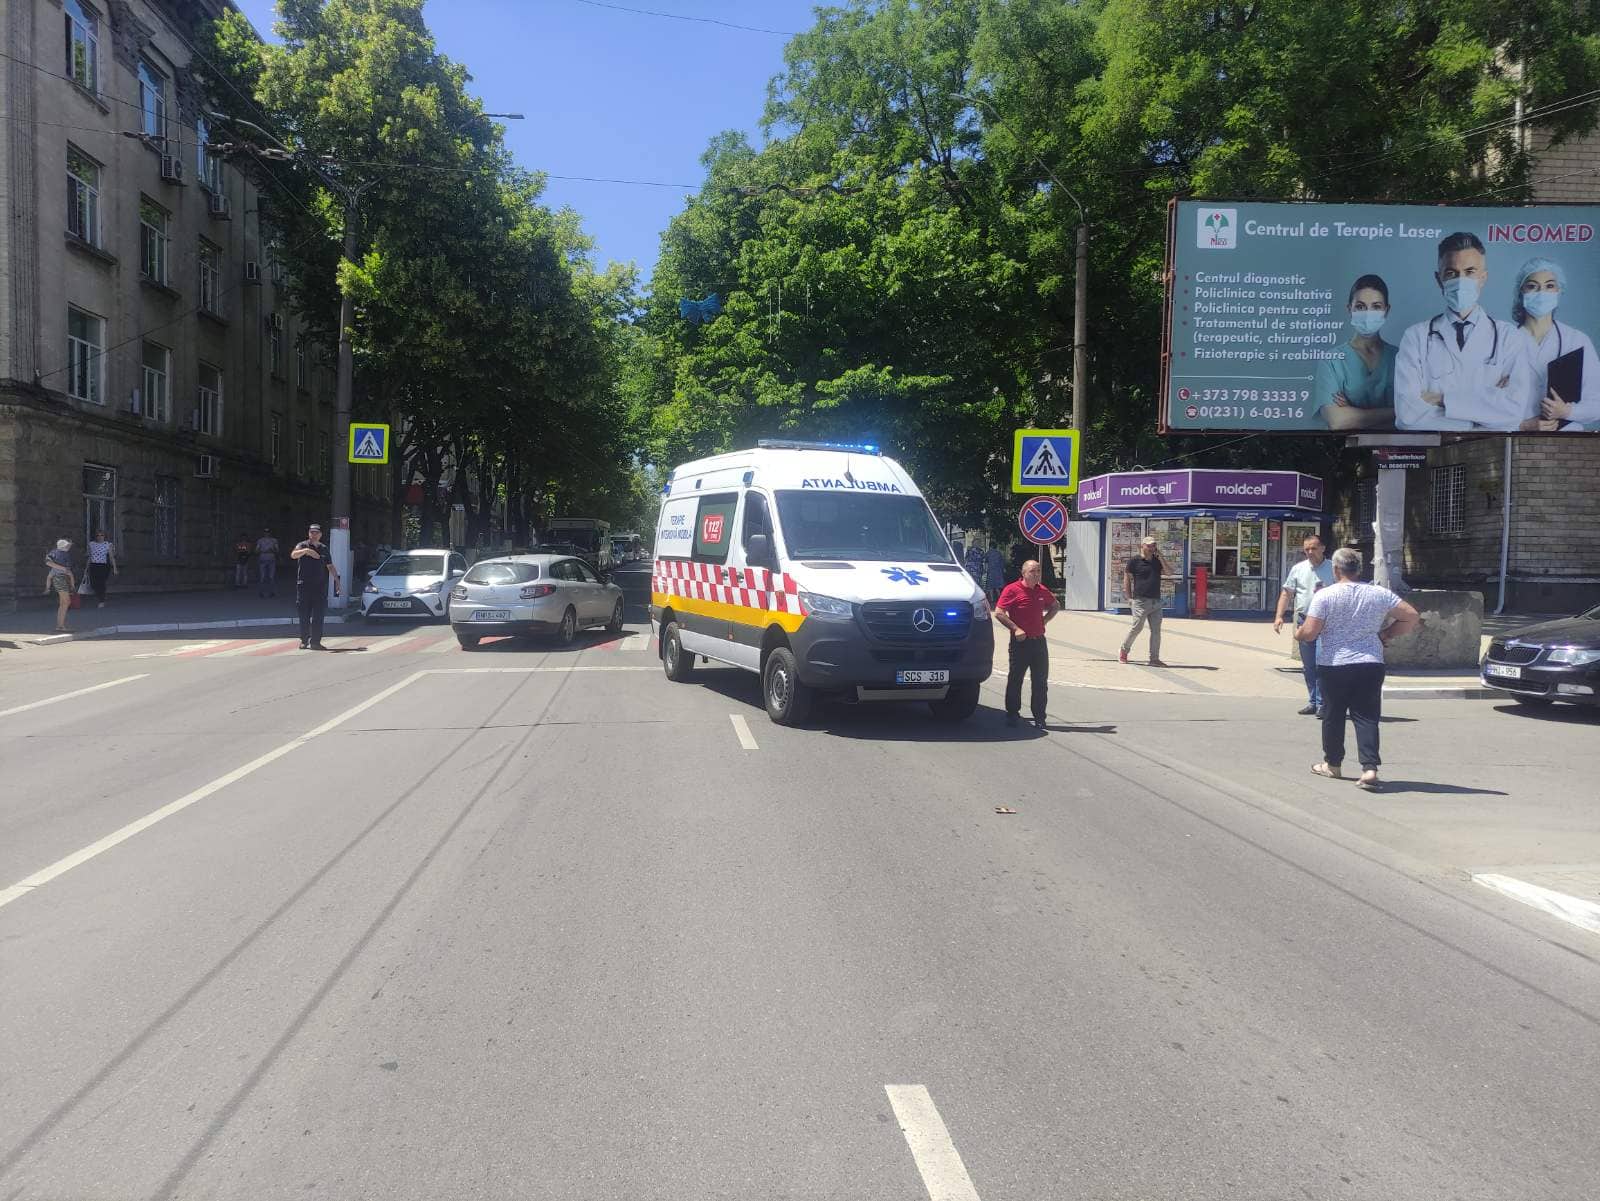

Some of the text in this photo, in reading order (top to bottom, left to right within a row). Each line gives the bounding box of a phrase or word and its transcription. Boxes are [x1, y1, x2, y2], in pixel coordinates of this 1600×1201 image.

[1244, 219, 1442, 240] Centrul de Terapie Laser
[1487, 223, 1593, 243] INCOMED
[1195, 271, 1306, 287] Centrul diagnostic
[1194, 287, 1333, 300] Policlinica consultativă
[1194, 302, 1332, 317] Policlinica pentru copii
[1193, 316, 1268, 329] Tratamentul
[1271, 318, 1286, 330] de
[1193, 331, 1337, 346] (terapeutic, chirurgical)
[1194, 348, 1265, 362] Fizioterapie
[1282, 349, 1345, 361] reabilitare
[1232, 389, 1259, 401] 798
[1200, 406, 1304, 419] 0(231) 6-03-16
[1120, 481, 1172, 496] moldcell
[1215, 482, 1267, 496] moldcell
[708, 520, 719, 533] 112
[905, 671, 945, 682] SCS 318
